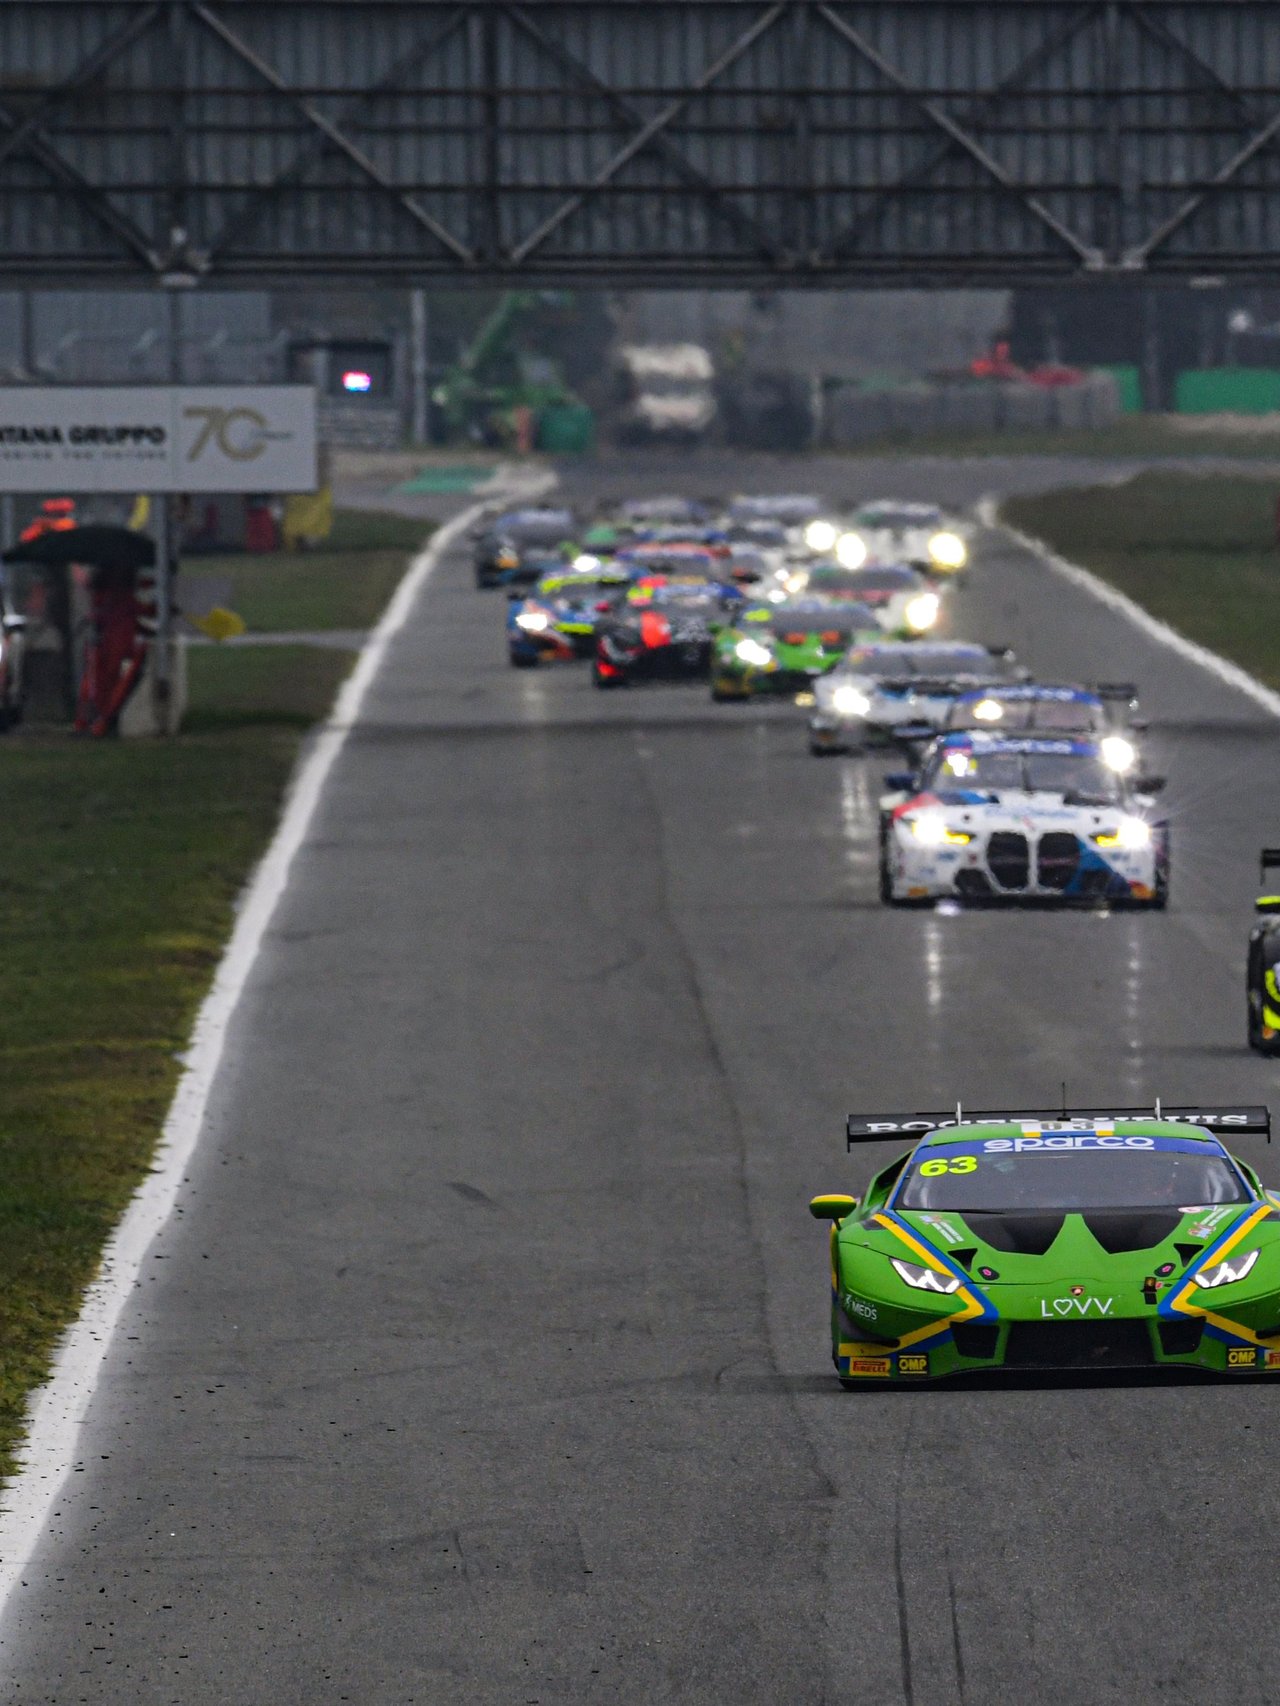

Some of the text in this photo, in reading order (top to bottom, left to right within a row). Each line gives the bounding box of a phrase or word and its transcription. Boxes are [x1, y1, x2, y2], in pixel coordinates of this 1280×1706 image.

[68, 426, 166, 445] GRUPPO
[984, 1136, 1155, 1153] sparco
[919, 1156, 978, 1177] 63
[852, 1304, 877, 1320] MEDS
[900, 1358, 926, 1370] OMP
[1228, 1351, 1255, 1364] OMP
